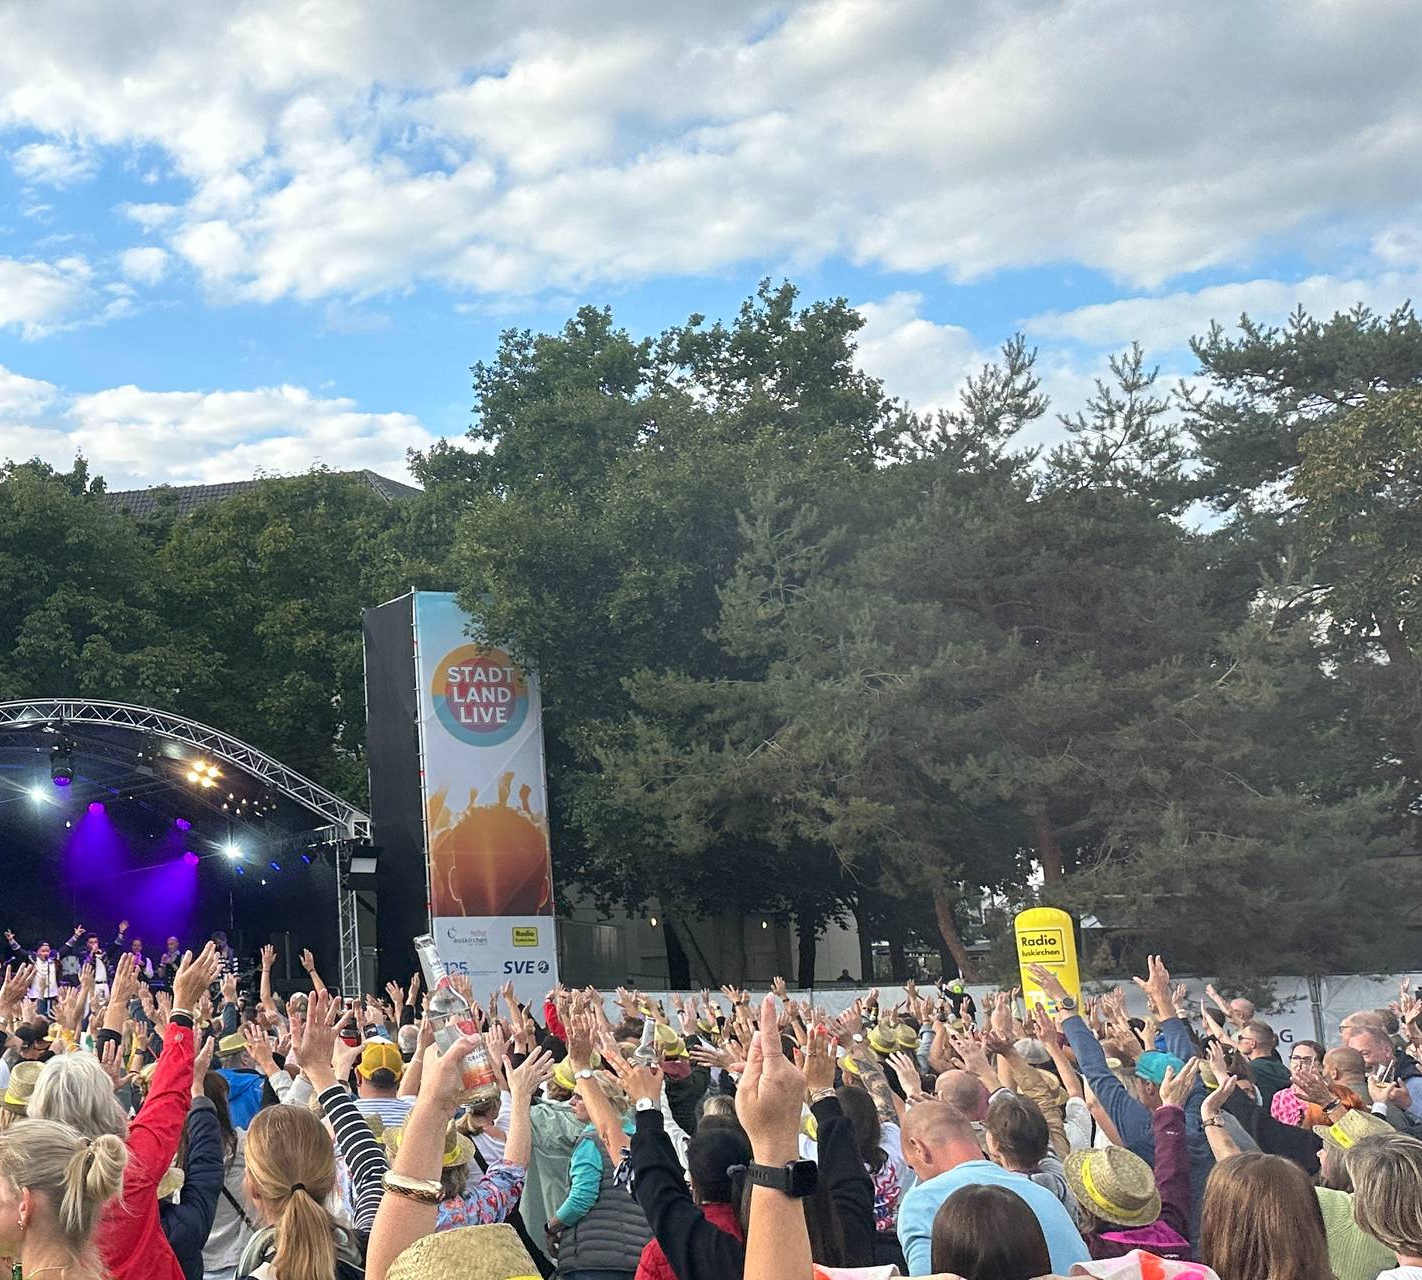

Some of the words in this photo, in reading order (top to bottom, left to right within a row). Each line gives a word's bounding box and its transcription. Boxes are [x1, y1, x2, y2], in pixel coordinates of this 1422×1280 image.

[447, 666, 515, 683] STADT
[453, 686, 511, 703] LAND
[460, 707, 508, 723] LIVE
[1021, 934, 1057, 947] Radio
[503, 961, 535, 975] SVE
